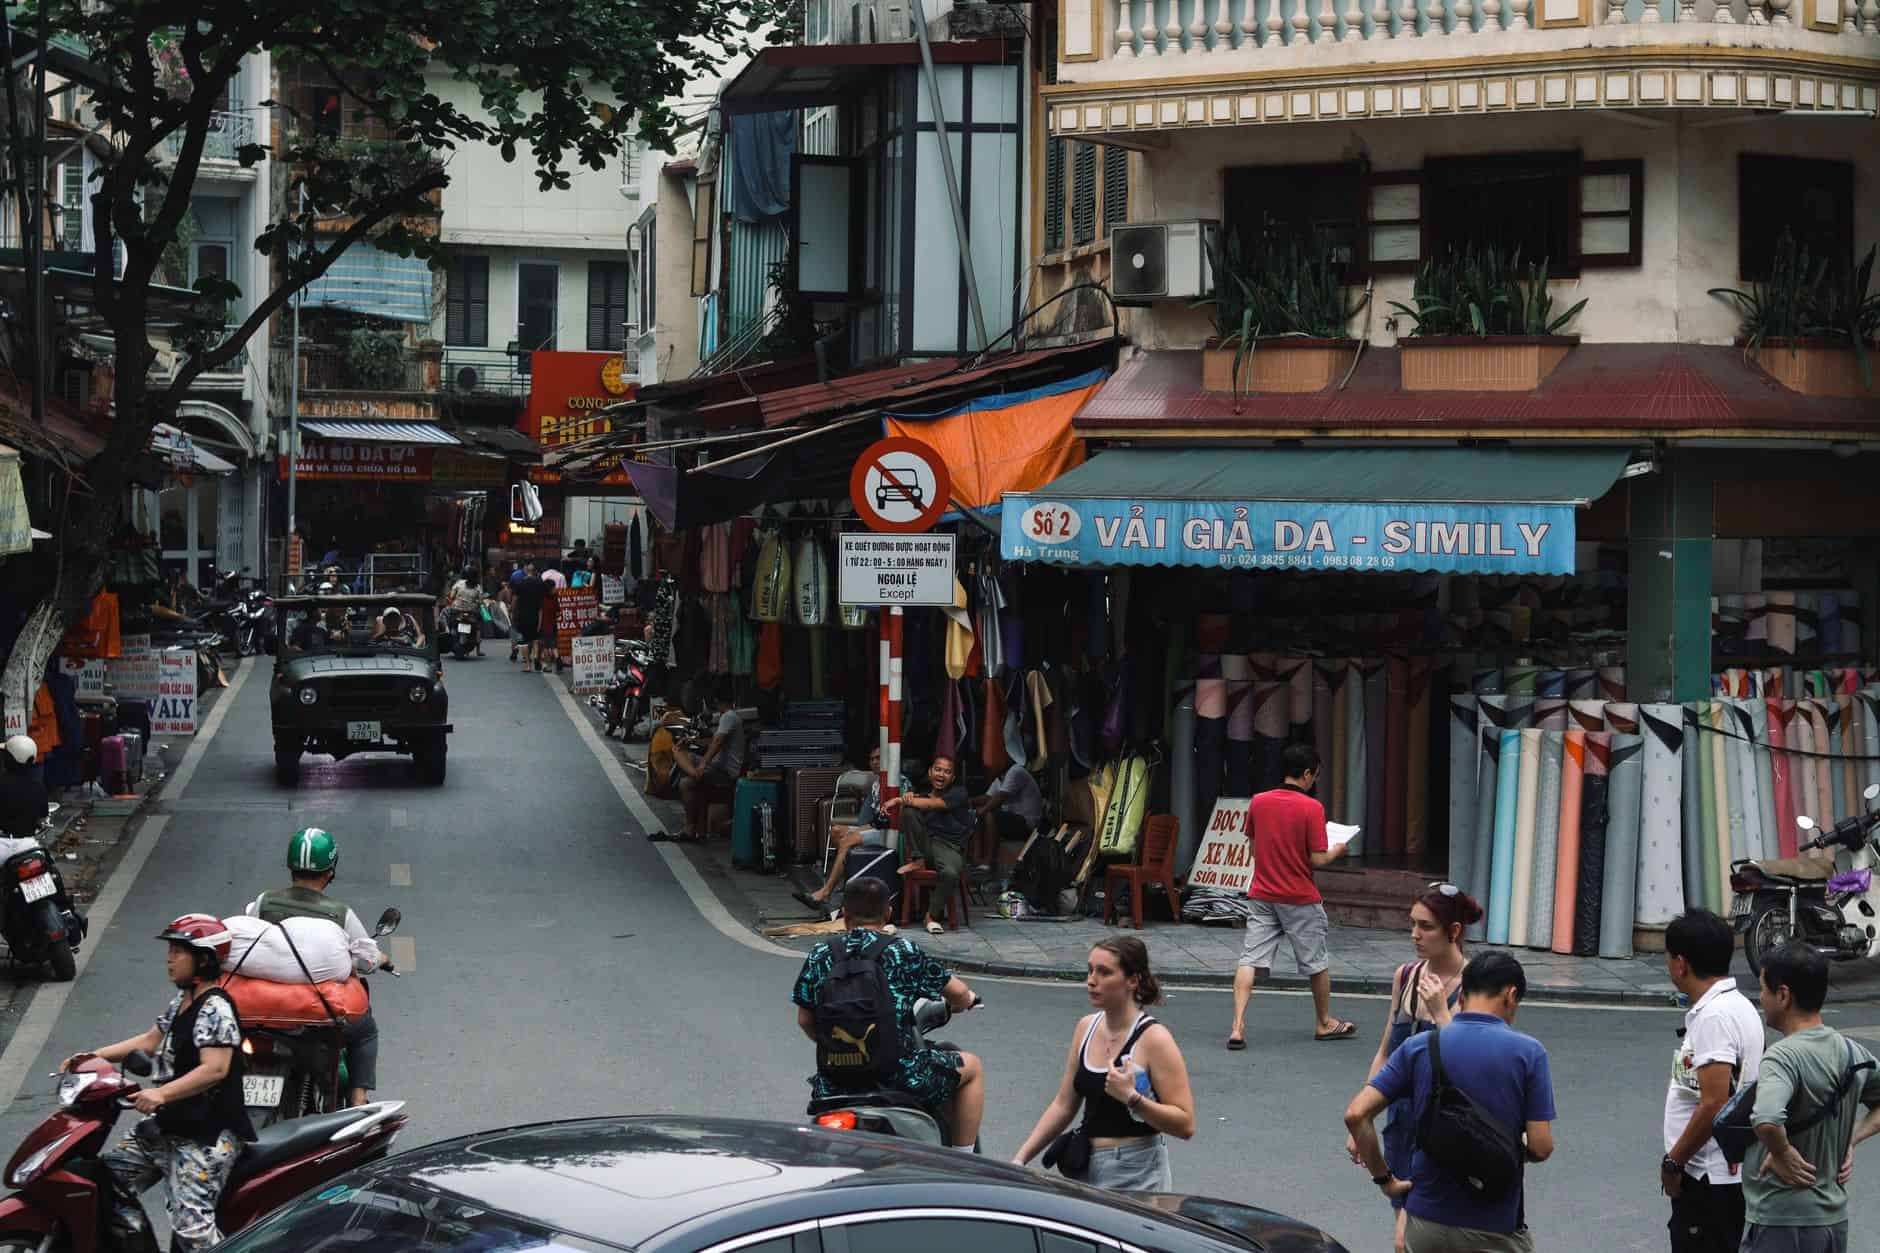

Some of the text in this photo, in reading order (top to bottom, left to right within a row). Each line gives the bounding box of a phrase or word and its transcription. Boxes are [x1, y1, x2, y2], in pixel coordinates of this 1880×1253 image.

[1032, 508, 1070, 537] Số 2
[1094, 504, 1167, 549] VẢI
[1182, 506, 1255, 552] GIẢ
[1274, 520, 1336, 553] DA
[1381, 520, 1551, 557] SIMILY
[845, 541, 854, 551] XE
[1014, 544, 1080, 561] Hà Trung
[1238, 555, 1257, 566] 024
[1260, 555, 1284, 566] 3825
[1287, 555, 1313, 566] 8841
[1323, 556, 1348, 567] 0983
[1350, 556, 1362, 567] 08
[1366, 556, 1379, 567] 28
[1382, 556, 1395, 568] 03
[878, 571, 917, 588] NGOẠI LỆ
[880, 588, 914, 600] Except
[146, 699, 193, 718] VALY
[1103, 802, 1118, 848] LIEN A
[1211, 808, 1240, 836] BỌC
[1202, 842, 1225, 865] XE
[1220, 872, 1248, 888] VALY
